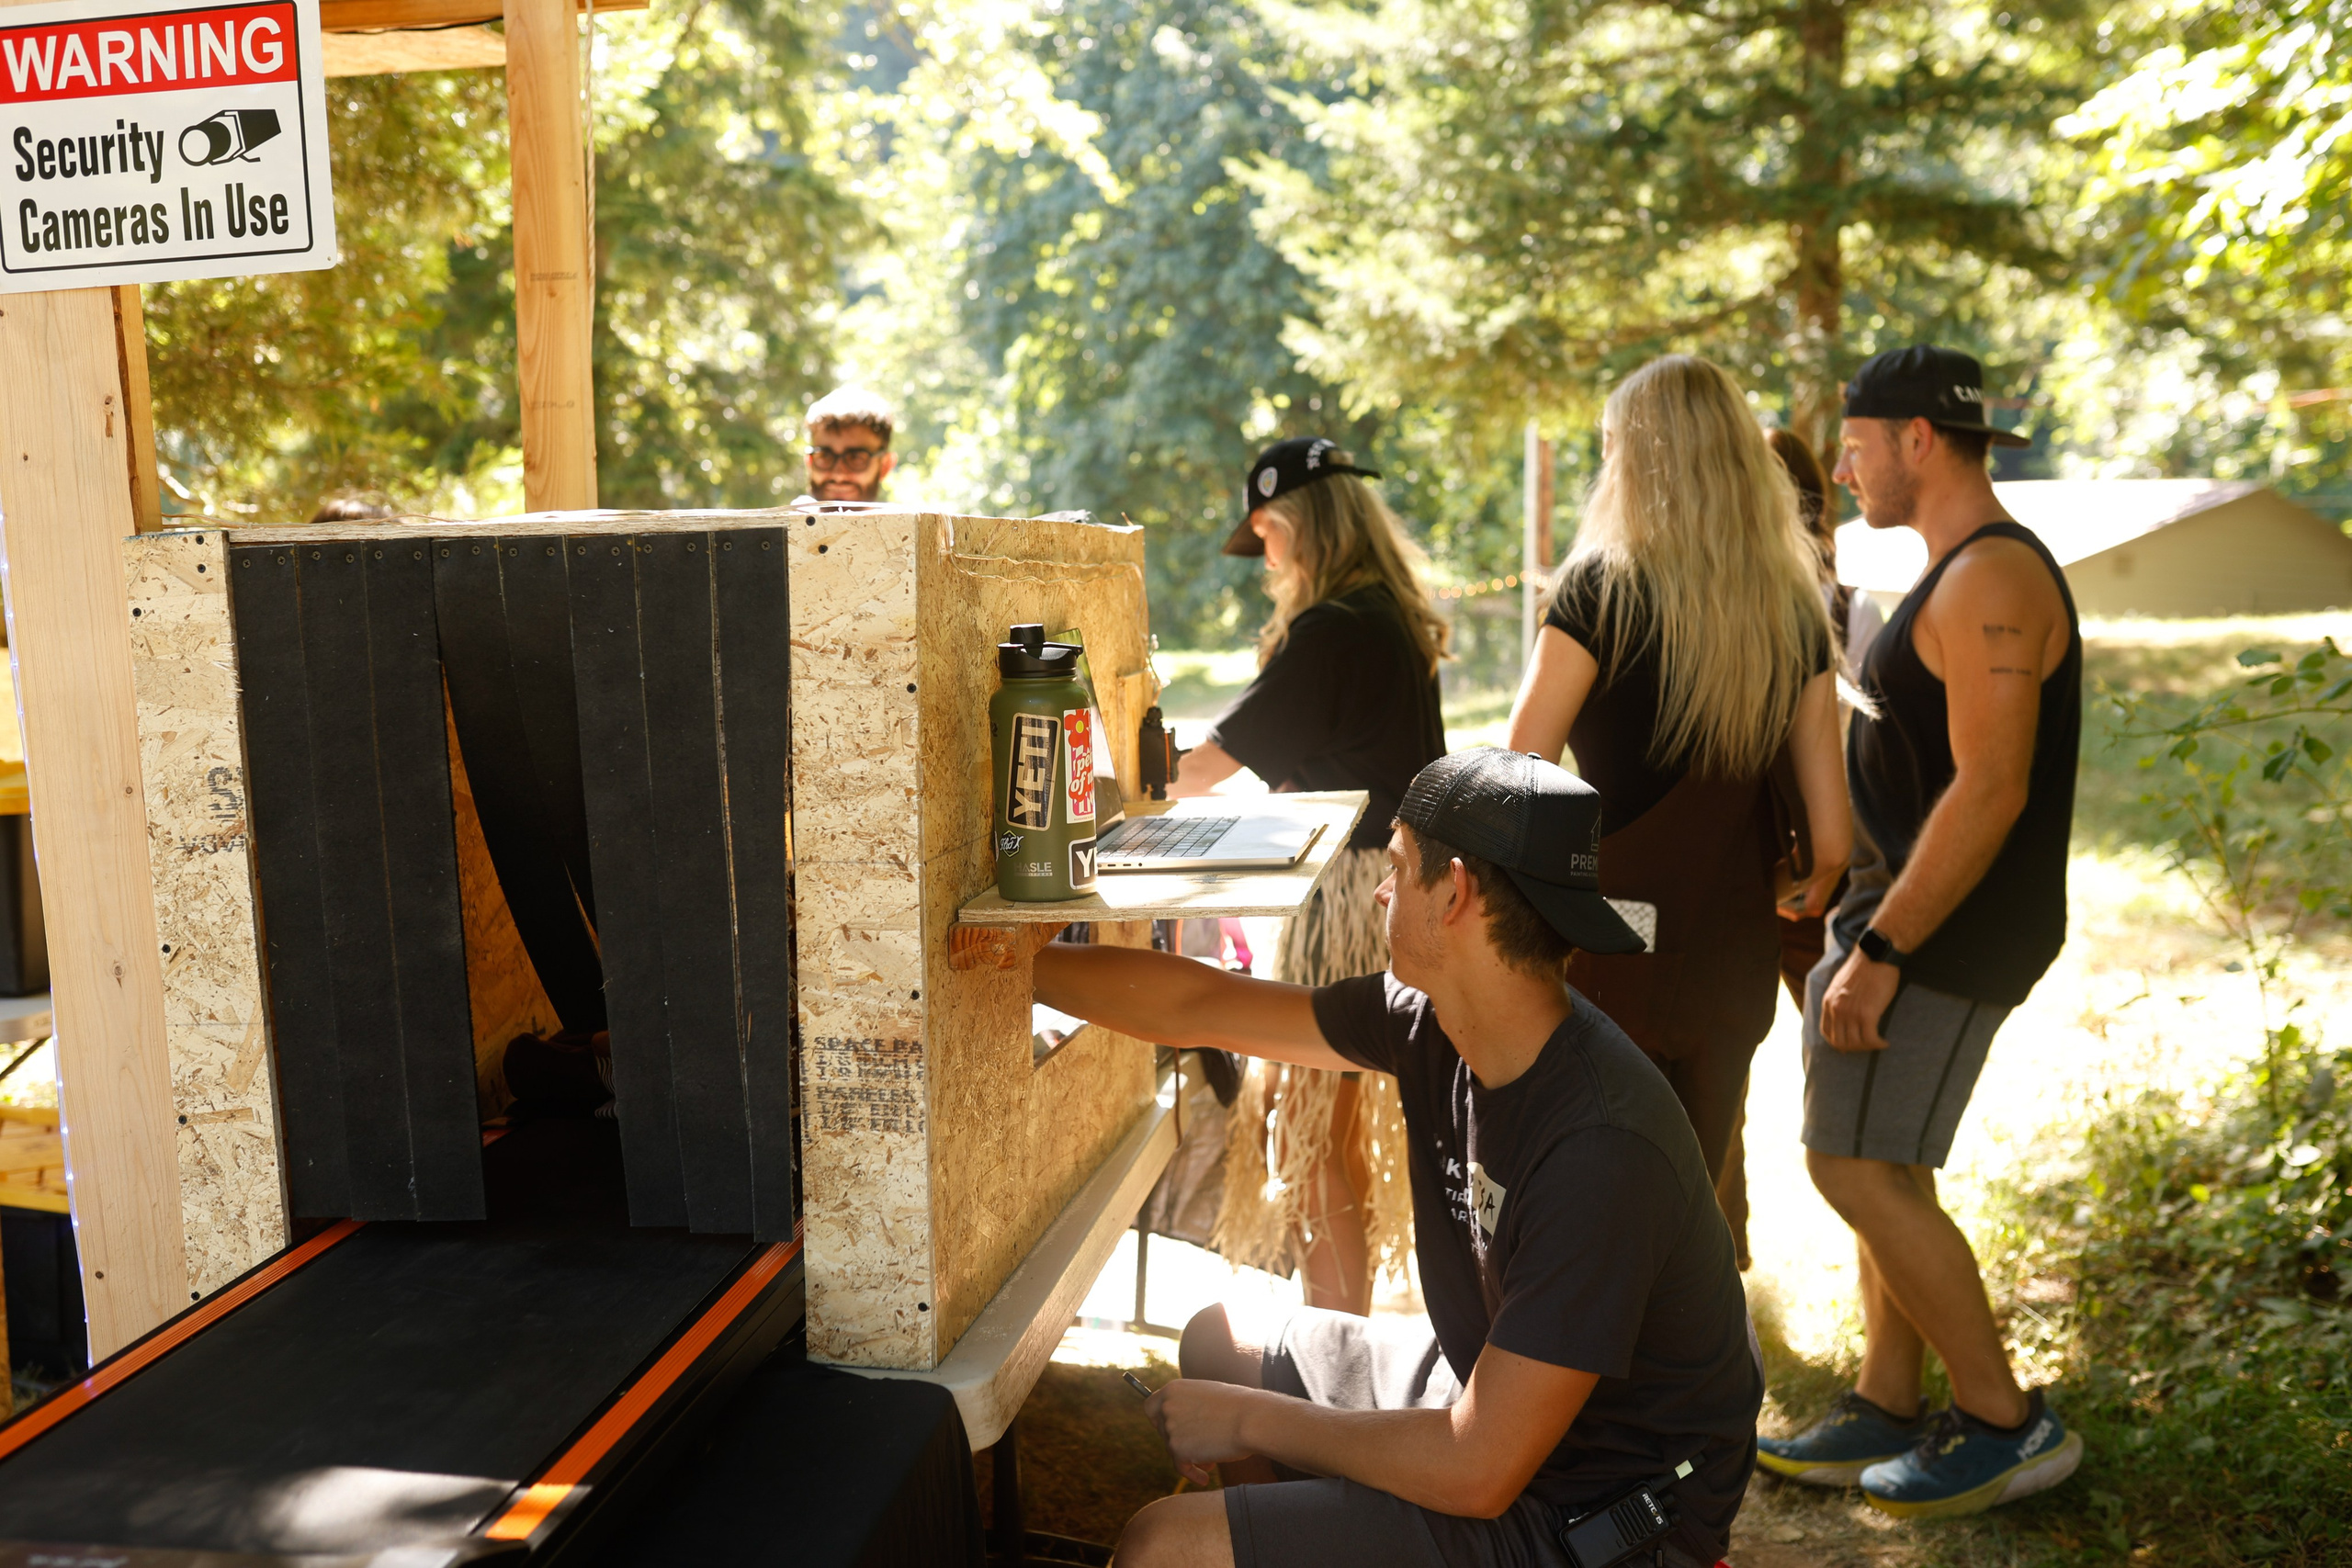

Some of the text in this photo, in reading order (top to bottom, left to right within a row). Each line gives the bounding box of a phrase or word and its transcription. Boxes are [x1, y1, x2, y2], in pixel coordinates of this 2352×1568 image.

[2, 17, 284, 94] WARNING
[13, 118, 164, 184] Security
[19, 182, 289, 254] Cameras In Use
[1013, 725, 1051, 819] YETI
[1070, 771, 1087, 795] of
